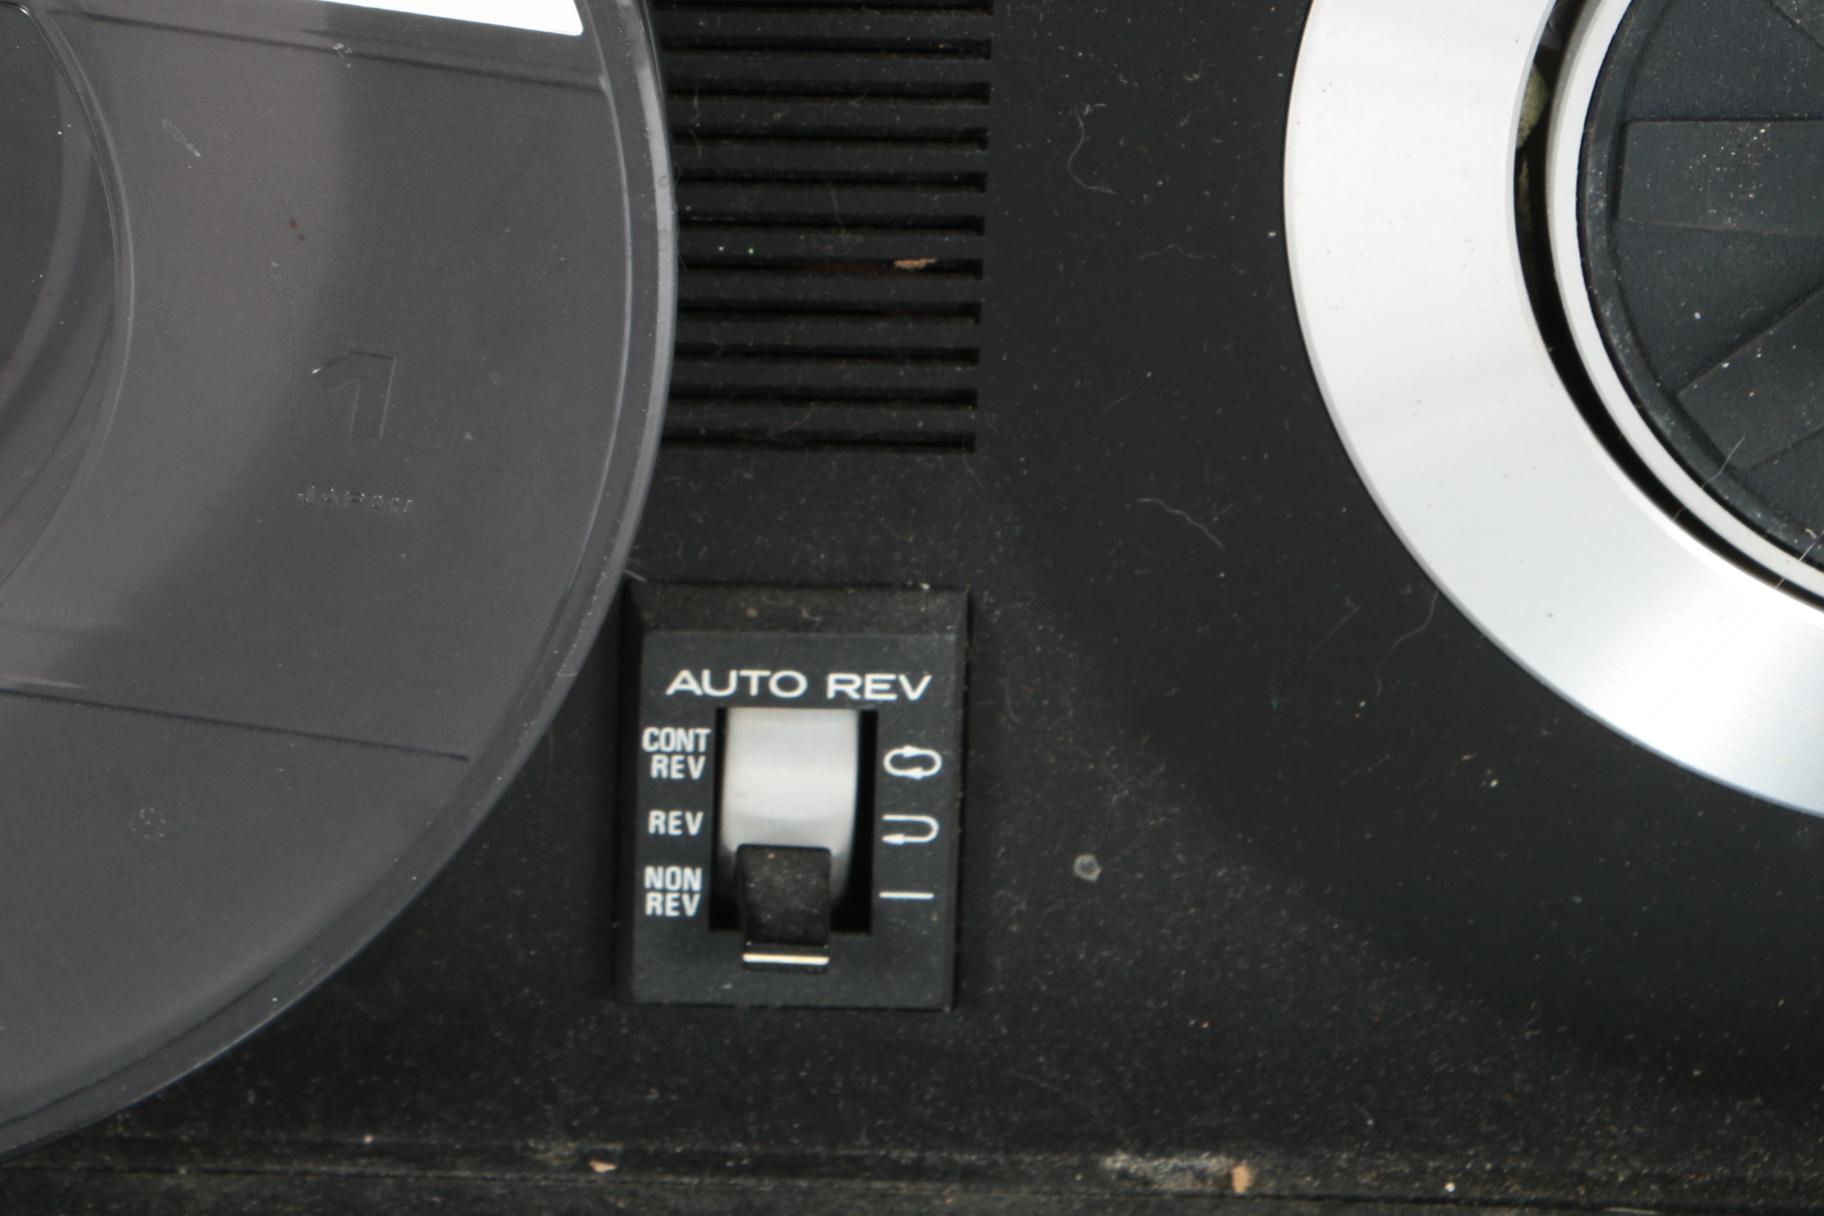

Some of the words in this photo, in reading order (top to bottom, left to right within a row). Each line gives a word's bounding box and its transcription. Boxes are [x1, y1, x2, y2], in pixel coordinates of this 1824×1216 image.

[665, 668, 808, 699] AUTO
[826, 672, 933, 702] REV
[641, 726, 712, 753] CONT
[650, 753, 706, 780] REV
[648, 809, 704, 836] REV
[644, 865, 703, 893] NON
[645, 890, 701, 917] REV
